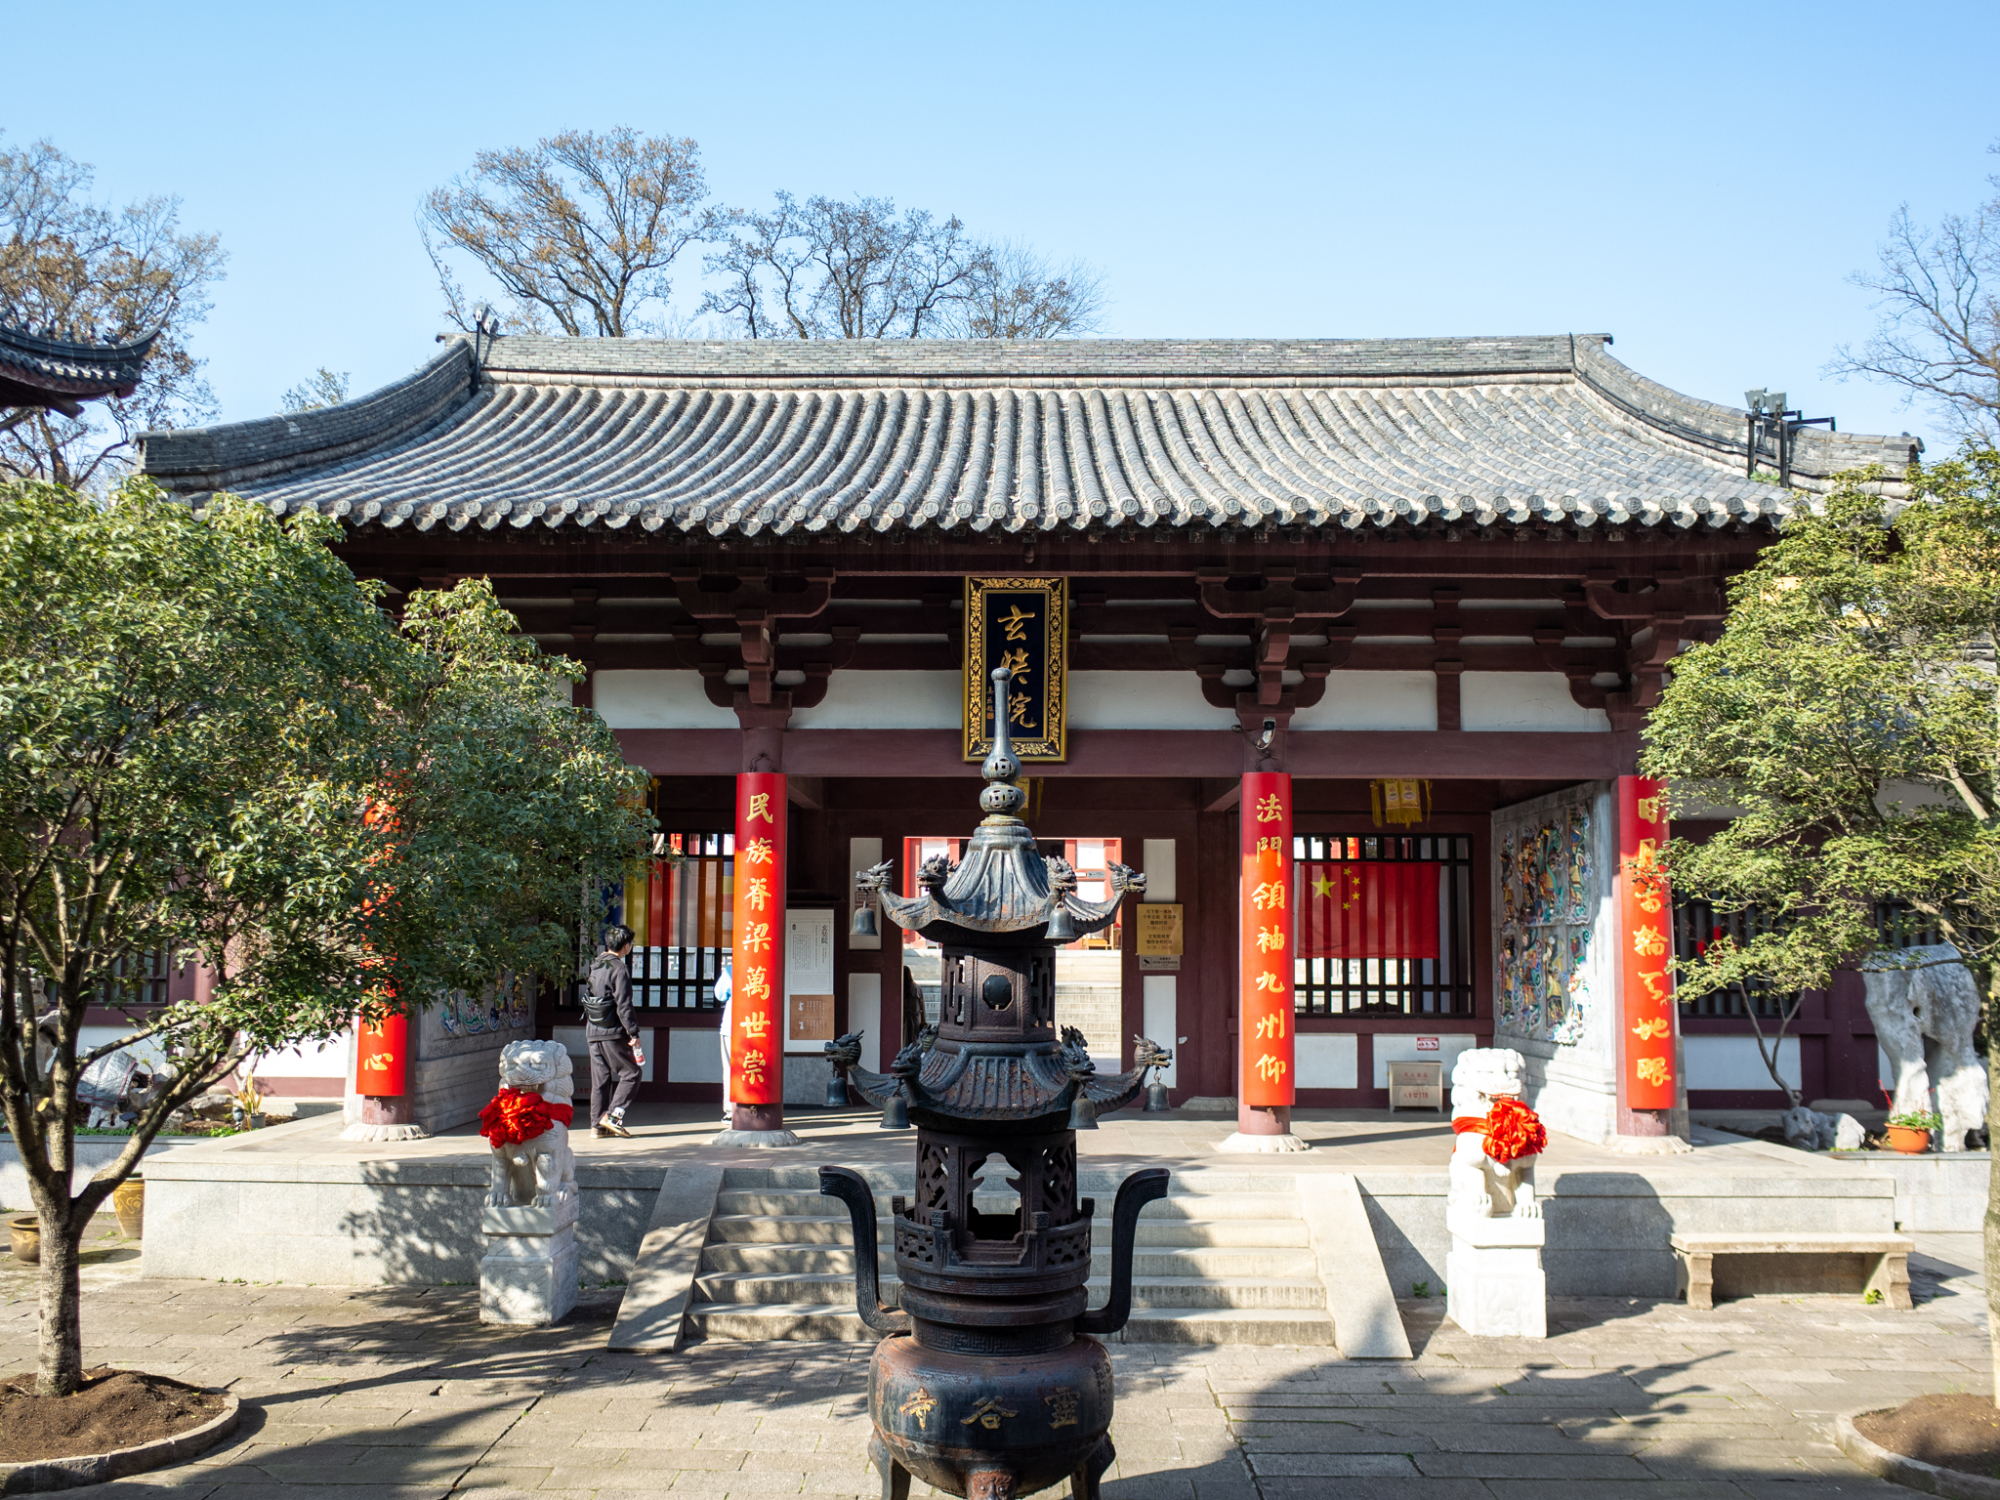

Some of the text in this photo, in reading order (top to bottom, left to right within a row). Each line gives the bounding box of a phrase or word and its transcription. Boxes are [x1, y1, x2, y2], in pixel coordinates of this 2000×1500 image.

[739, 792, 774, 1085] 民族脊梁萬世崇
[1251, 793, 1287, 1085] 法門領袖九州仰
